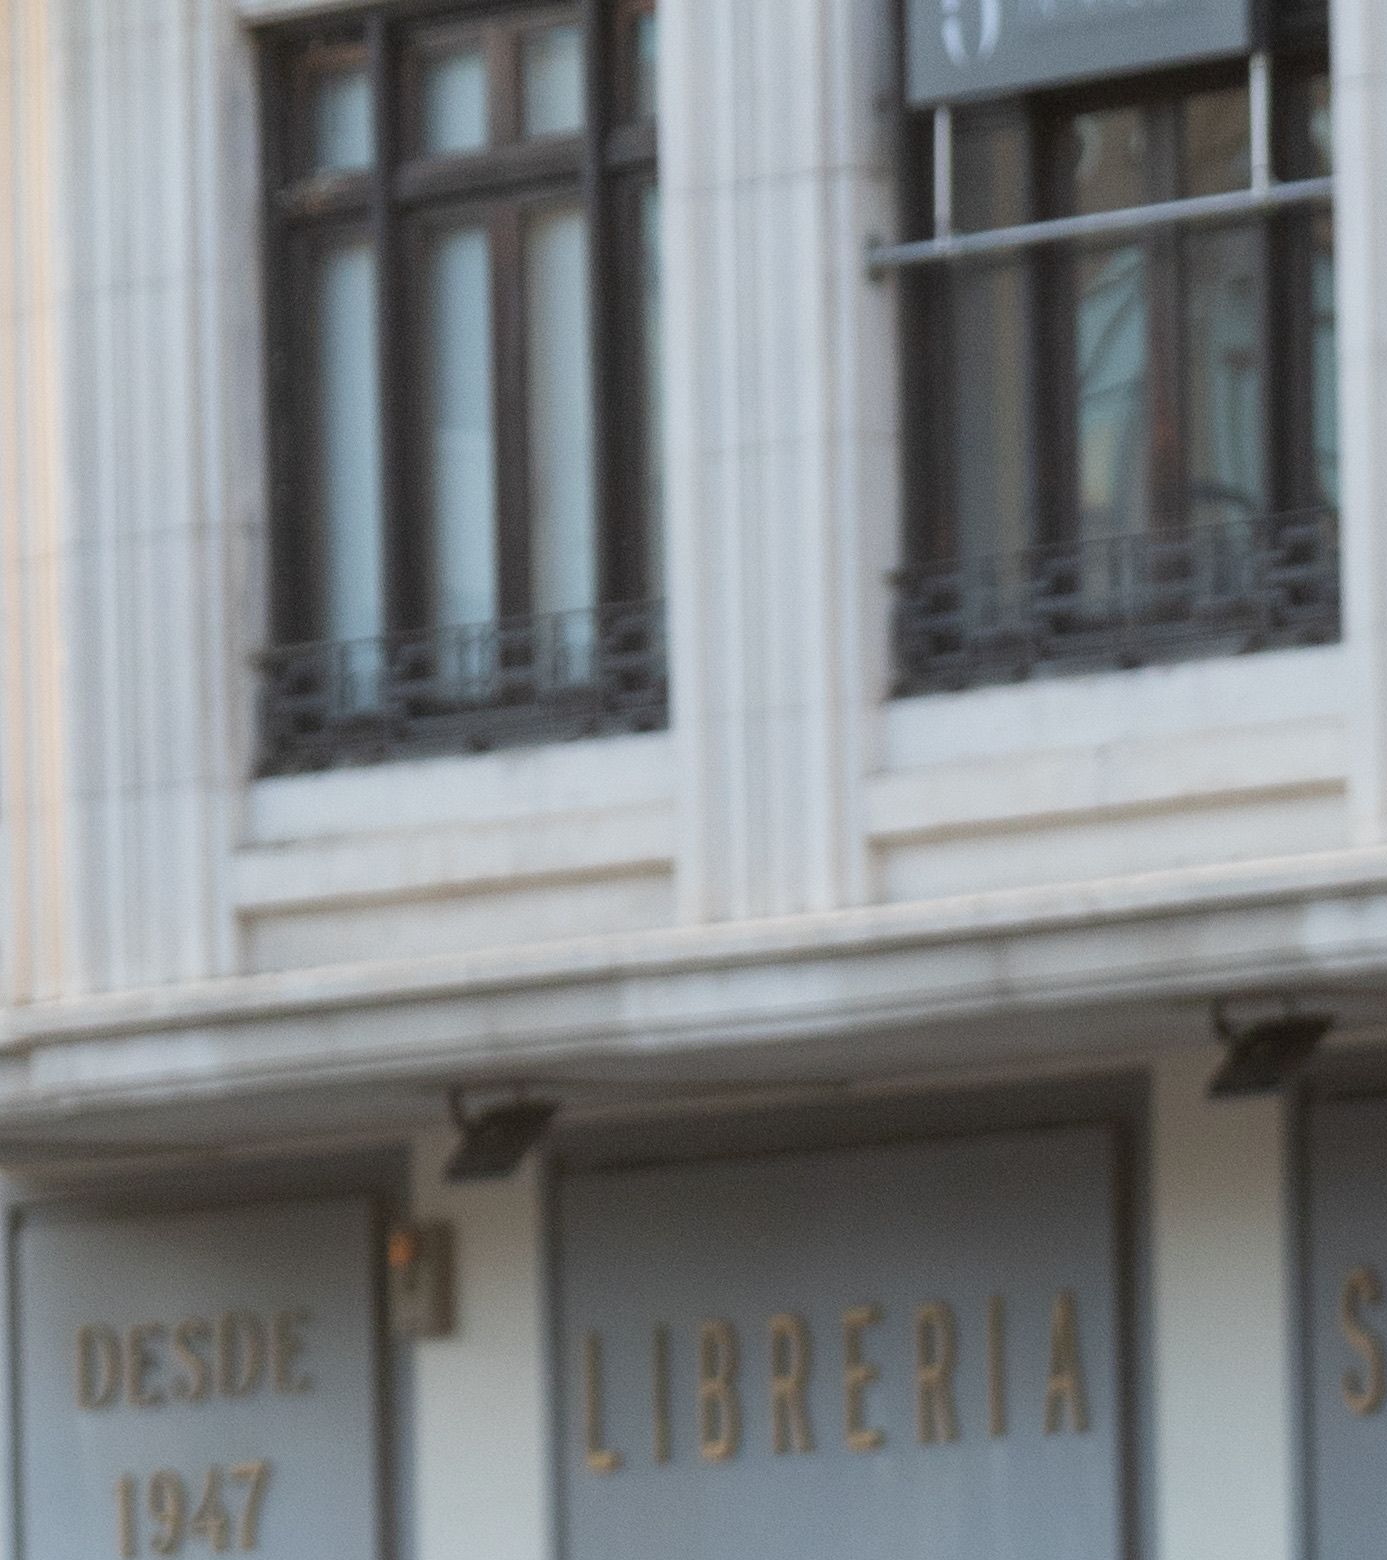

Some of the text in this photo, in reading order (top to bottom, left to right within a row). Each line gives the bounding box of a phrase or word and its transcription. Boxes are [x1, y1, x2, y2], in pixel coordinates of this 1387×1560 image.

[74, 1308, 312, 1412] DESDE
[582, 1288, 1090, 1474] LIBRERIA
[113, 1459, 272, 1560] 1947
